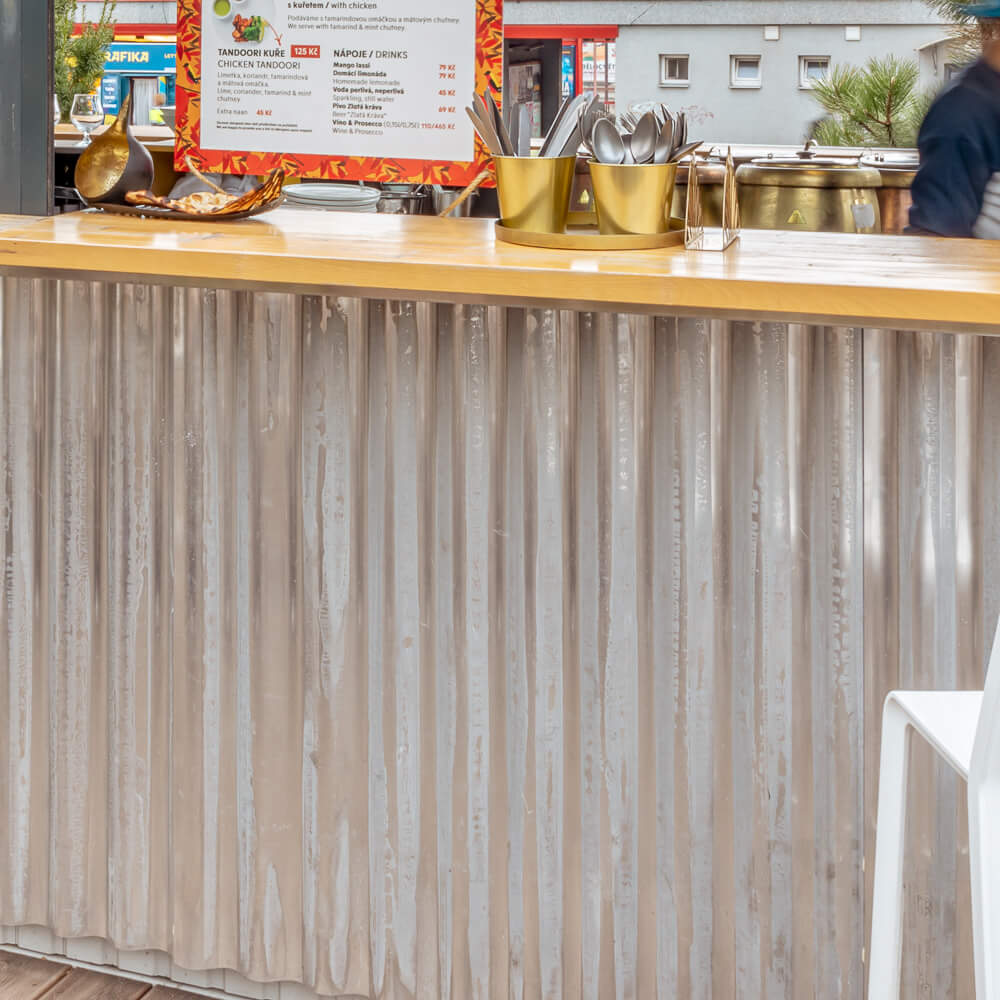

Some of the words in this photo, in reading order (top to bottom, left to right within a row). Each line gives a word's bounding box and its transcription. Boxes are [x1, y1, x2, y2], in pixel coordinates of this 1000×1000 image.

[218, 49, 261, 57] TANDOORI
[264, 48, 285, 57] KUŘE
[334, 48, 367, 58] NÁPOJE
[376, 50, 408, 59] DRINKS
[217, 60, 254, 68] CHICKEN
[256, 61, 301, 70] TANDOORI
